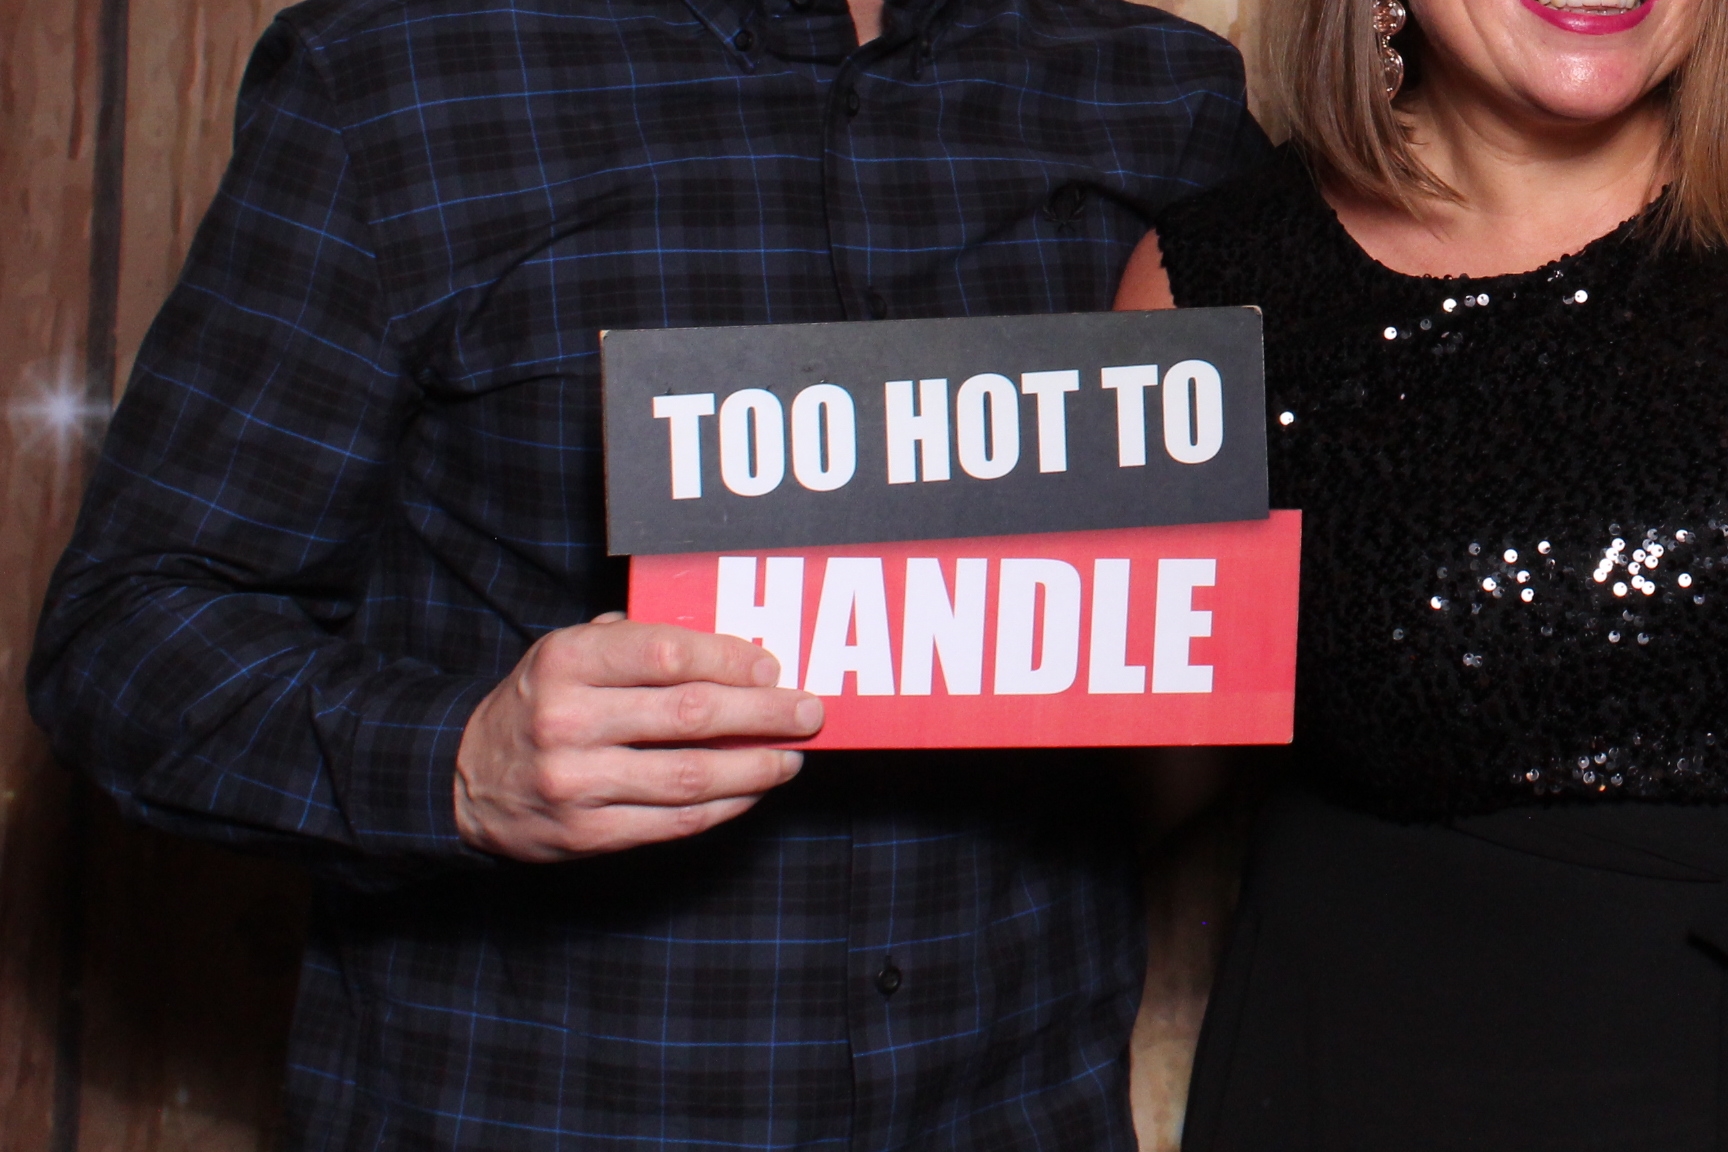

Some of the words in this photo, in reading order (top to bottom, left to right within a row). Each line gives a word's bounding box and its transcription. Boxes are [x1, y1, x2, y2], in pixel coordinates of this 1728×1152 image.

[652, 383, 857, 500] TOO
[884, 369, 1080, 485] HOT
[1100, 359, 1224, 468] TO
[714, 556, 1217, 696] HANDLE
